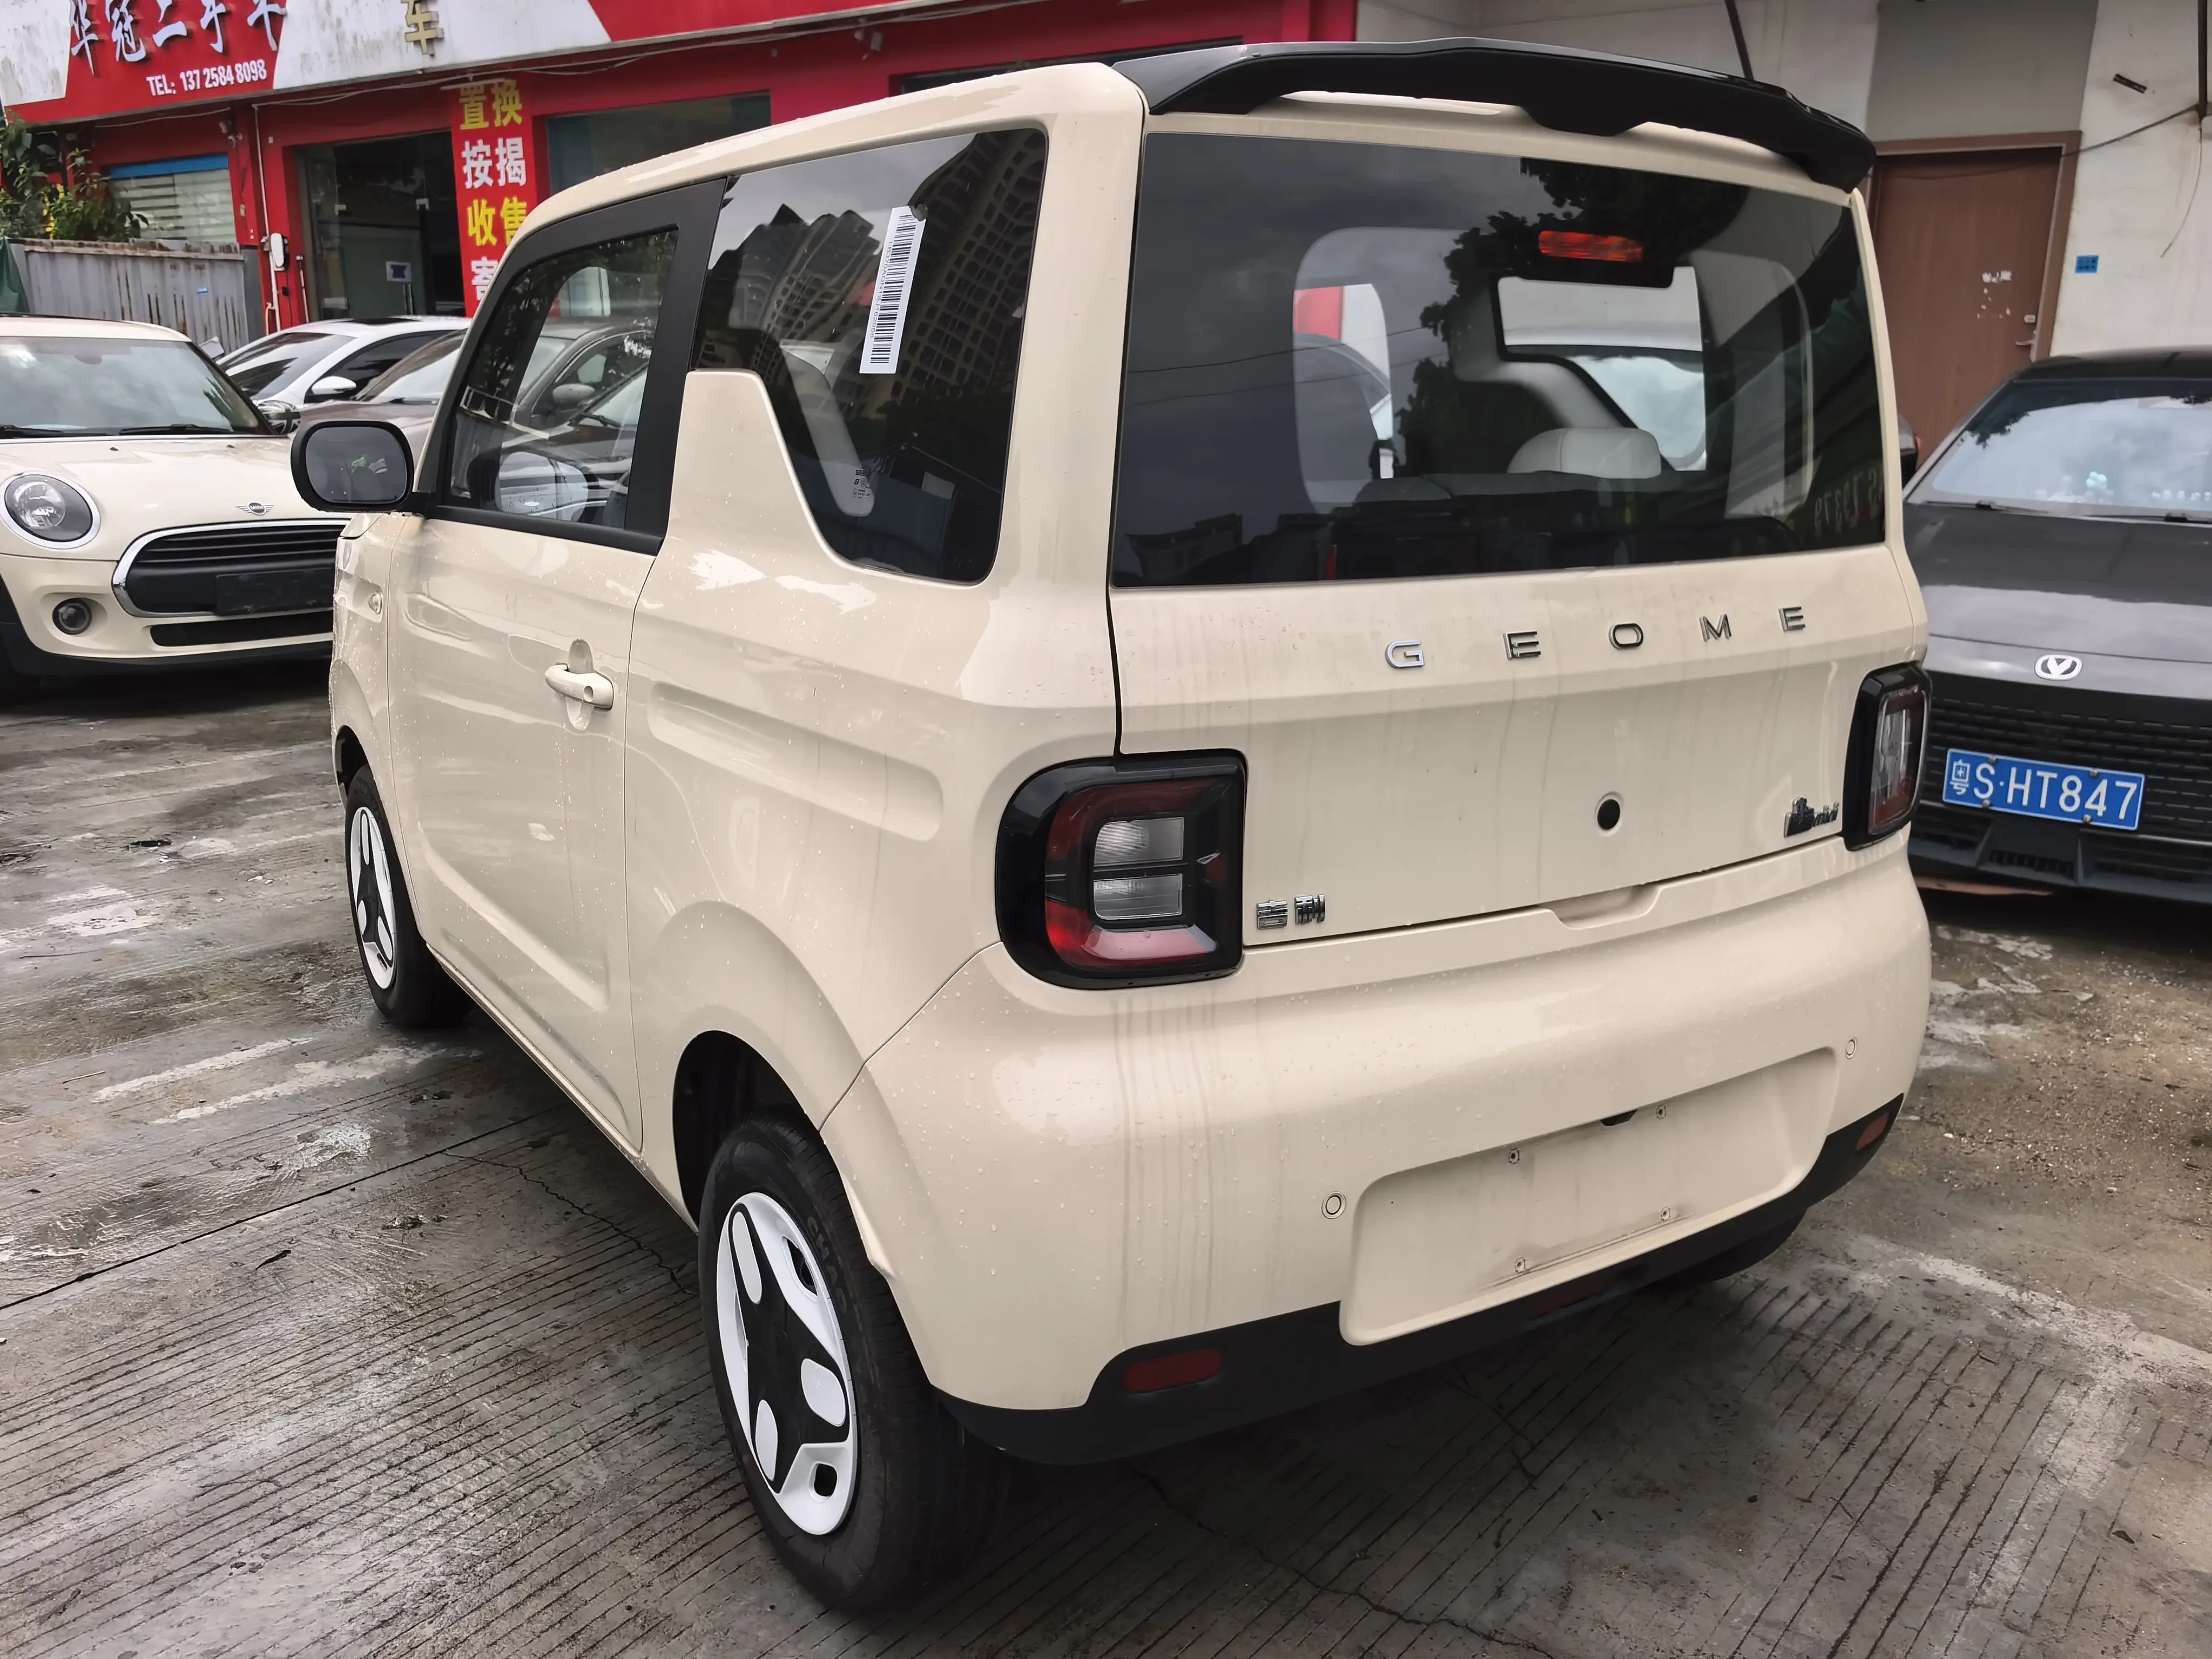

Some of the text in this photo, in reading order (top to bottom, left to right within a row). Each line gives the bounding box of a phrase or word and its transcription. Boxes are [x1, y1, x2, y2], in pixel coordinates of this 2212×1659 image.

[179, 70, 200, 91] 137
[460, 79, 522, 130] 置换
[462, 137, 527, 189] 按揭
[467, 197, 528, 247] 收售
[1385, 606, 1806, 668] GEOME
